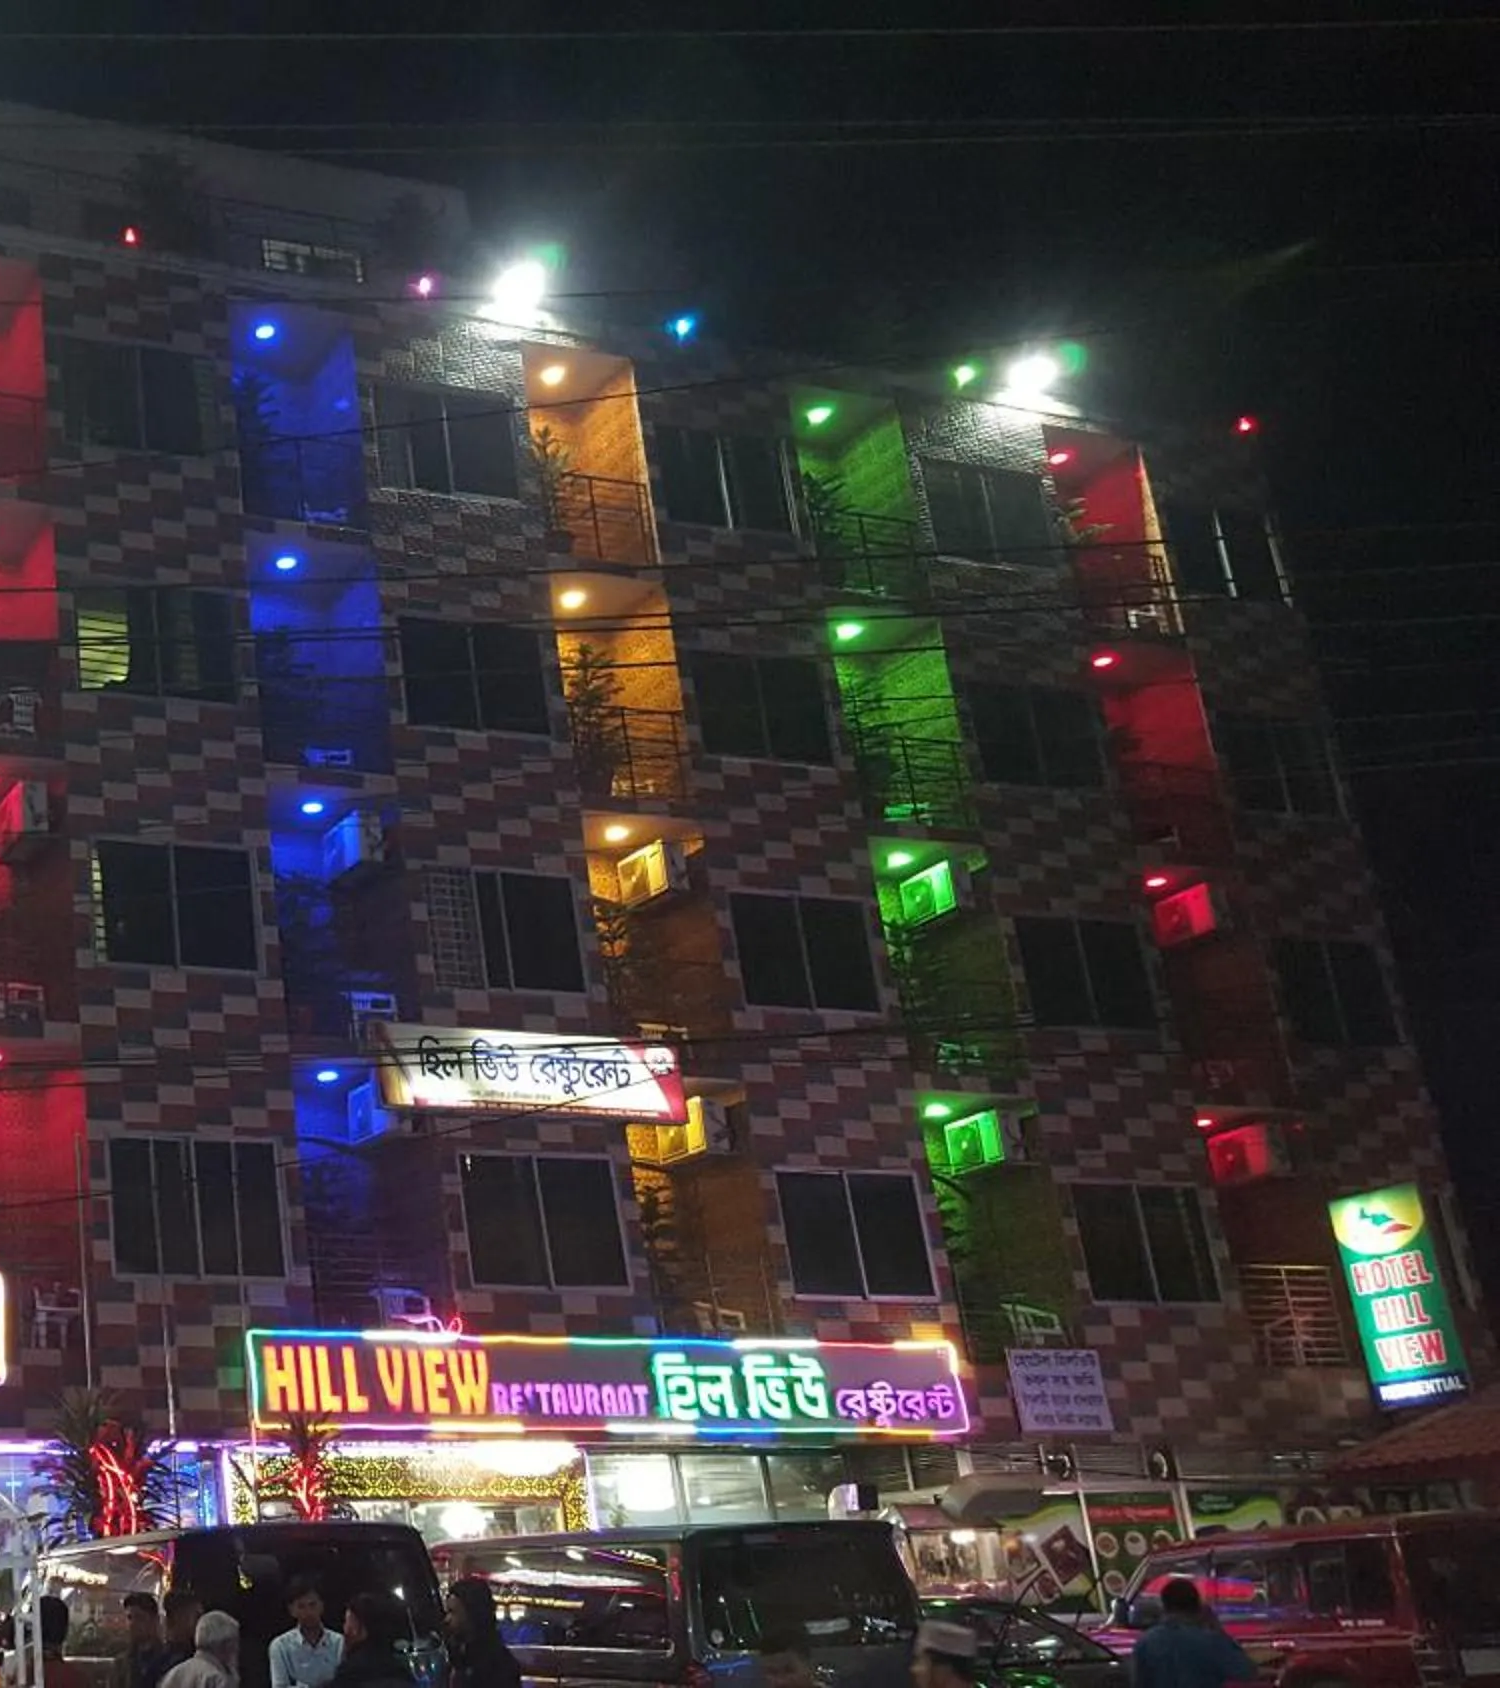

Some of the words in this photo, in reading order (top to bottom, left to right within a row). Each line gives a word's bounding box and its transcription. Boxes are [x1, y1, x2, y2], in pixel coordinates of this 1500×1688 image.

[418, 1035, 464, 1081] হিল
[471, 1037, 520, 1081] ভিউ
[1351, 1252, 1432, 1294] HOTEL
[1373, 1293, 1430, 1331] HILL
[1376, 1330, 1445, 1371] VIEW
[263, 1345, 369, 1414] HILL
[376, 1347, 489, 1415] VIEW
[652, 1352, 738, 1421] হিল
[741, 1353, 829, 1420] ভিউ
